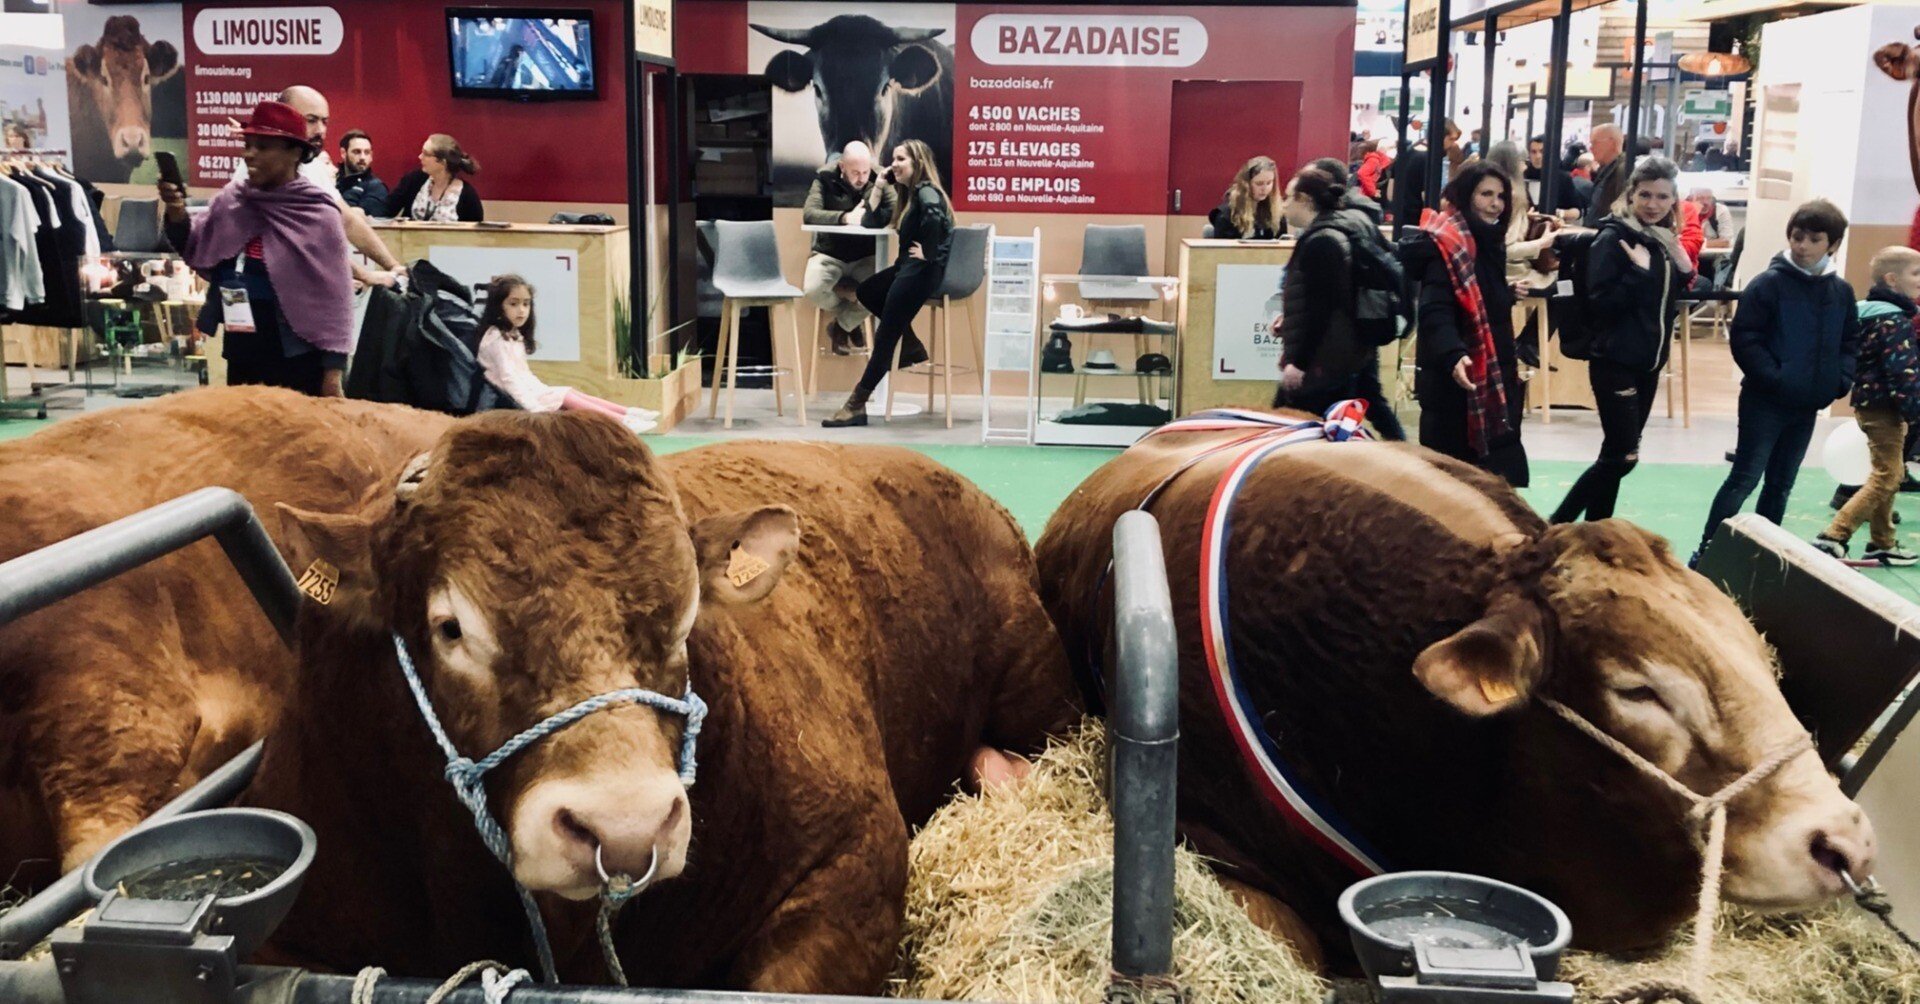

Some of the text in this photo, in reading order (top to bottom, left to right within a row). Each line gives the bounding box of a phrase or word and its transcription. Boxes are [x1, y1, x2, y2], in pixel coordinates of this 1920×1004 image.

[212, 18, 322, 45] LIMOUSINE
[998, 25, 1180, 56] BAZADAISE
[194, 65, 251, 79] limousine.org
[969, 76, 1054, 90] bazadaise.fr
[1017, 106, 1081, 121] VACHES
[968, 122, 988, 131] dont
[1013, 123, 1024, 132] en
[1025, 123, 1104, 134] Nouvelle-Aquitaine
[968, 138, 1081, 157] 175 ÉLEVAGES
[967, 157, 987, 167] dont
[1003, 159, 1015, 168] en
[1016, 158, 1095, 170] Nouvelle-Aquitaine
[967, 176, 1081, 193] 1050 EMPLOIS
[966, 193, 987, 202] dont
[1017, 194, 1096, 204] Nouvelle-Aquitaine
[298, 568, 335, 602] 7255
